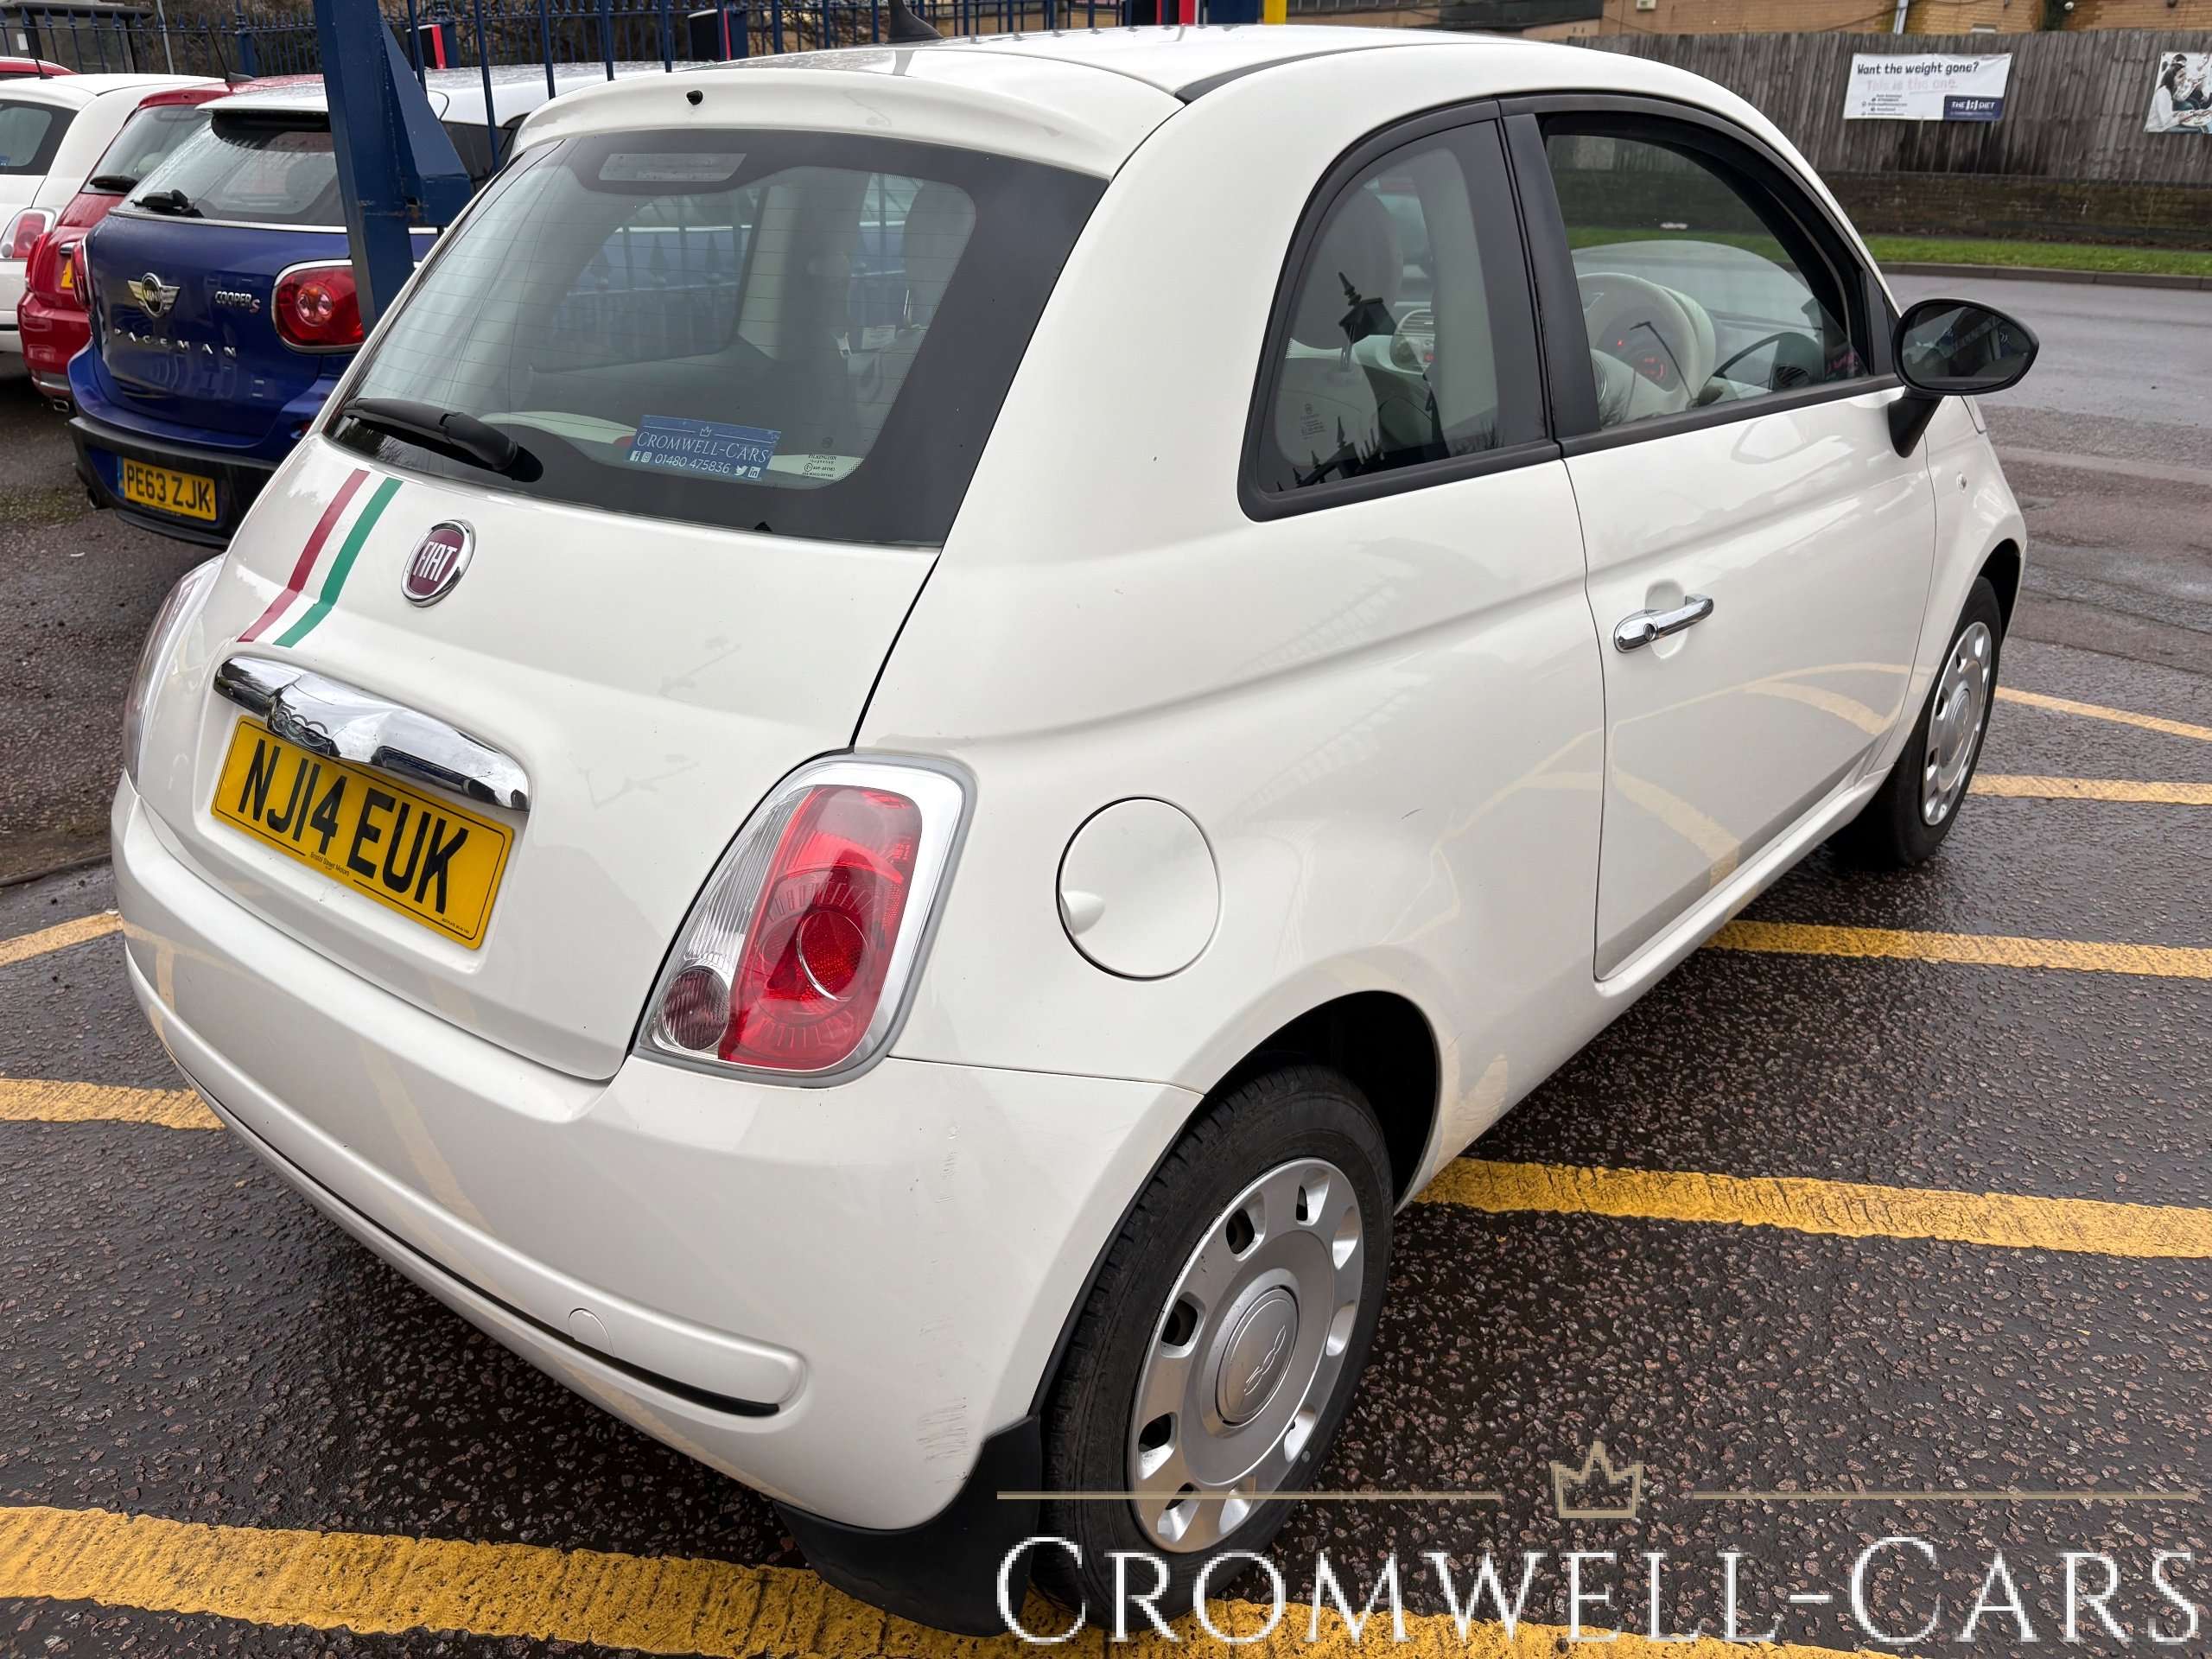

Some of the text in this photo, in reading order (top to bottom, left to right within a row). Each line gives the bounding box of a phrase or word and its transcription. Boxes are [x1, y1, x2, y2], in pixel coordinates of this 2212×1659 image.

[1857, 60, 1980, 76] Want the weight gone?
[1951, 101, 1966, 110] THE
[1978, 101, 1996, 110] DIET
[144, 289, 162, 302] MINI
[215, 290, 252, 306] COOPER
[114, 328, 237, 357] PACEMAN
[637, 432, 769, 463] CROMWELL-CARS
[655, 454, 688, 467] 01480
[689, 459, 731, 474] 475836
[126, 464, 212, 513] PE63 ZJK
[413, 540, 458, 583] FIAT
[238, 738, 469, 914] NJ14 EUK
